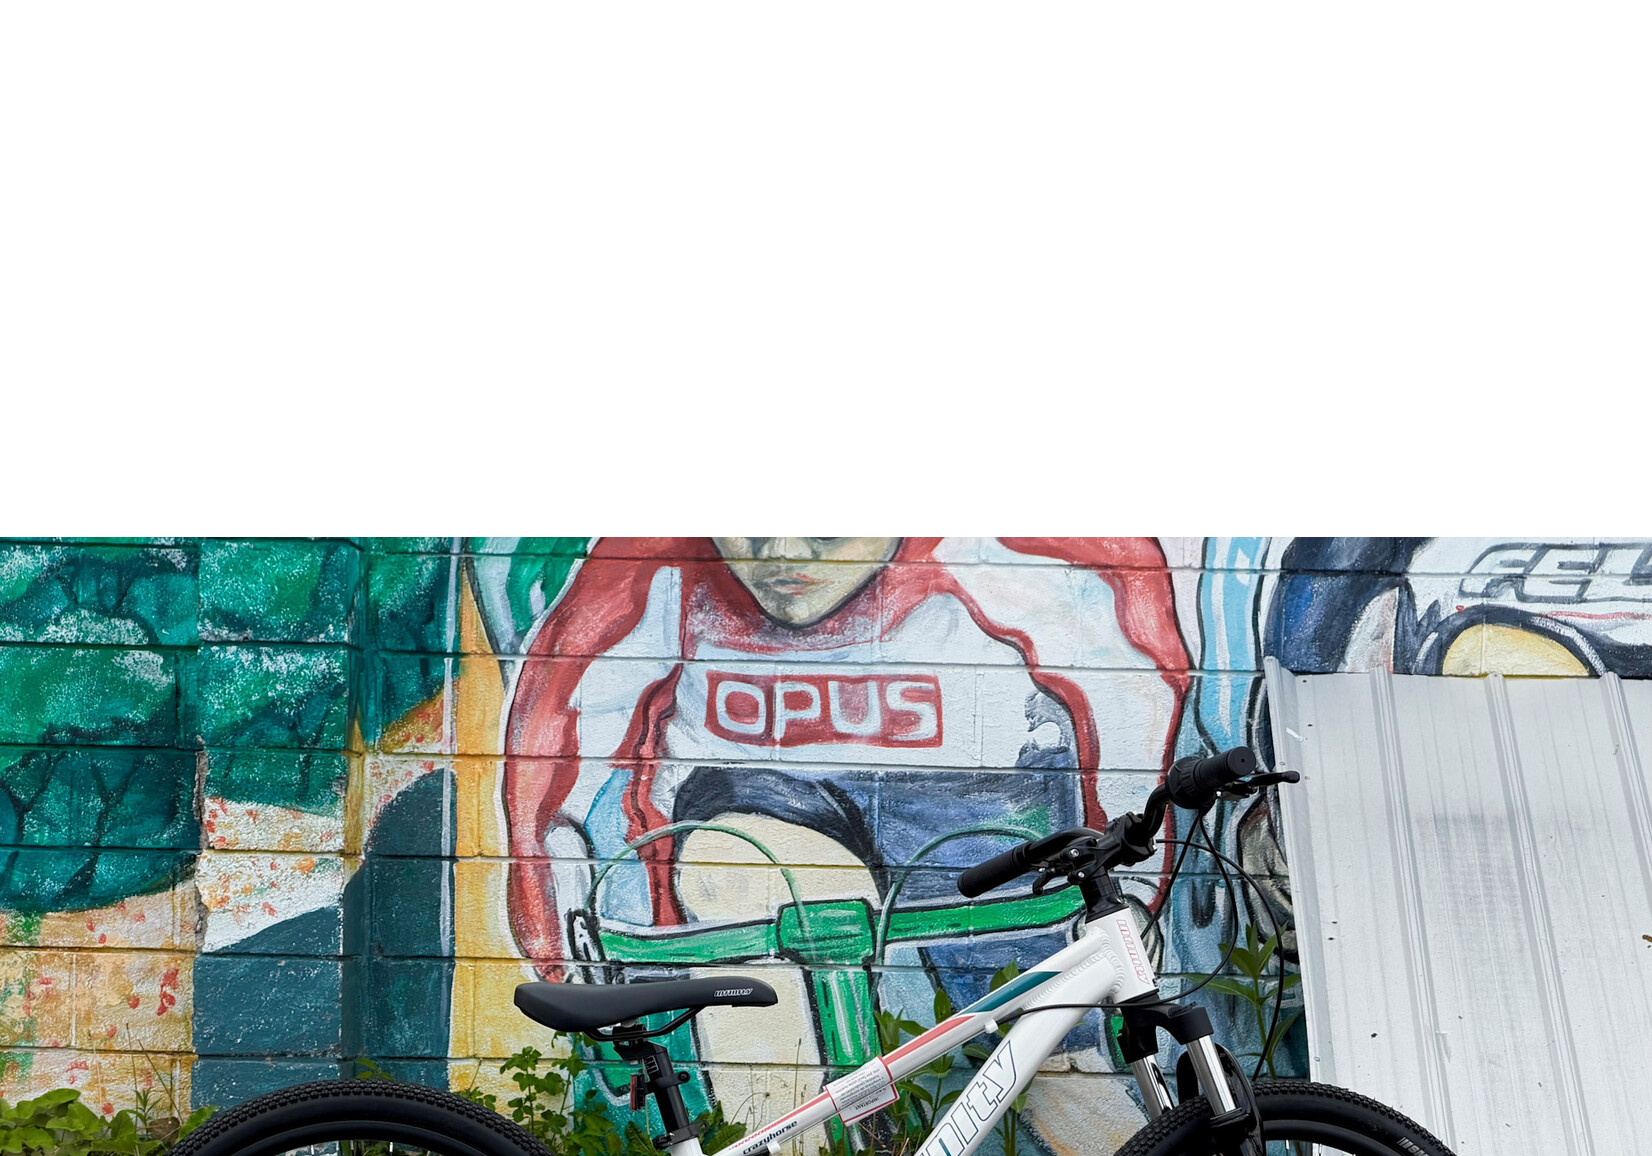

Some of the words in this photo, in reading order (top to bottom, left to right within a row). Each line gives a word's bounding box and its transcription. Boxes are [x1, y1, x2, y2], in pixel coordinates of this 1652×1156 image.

[1457, 541, 1652, 604] FEL
[716, 679, 937, 742] OPUS
[743, 1120, 797, 1155] crazyhorse
